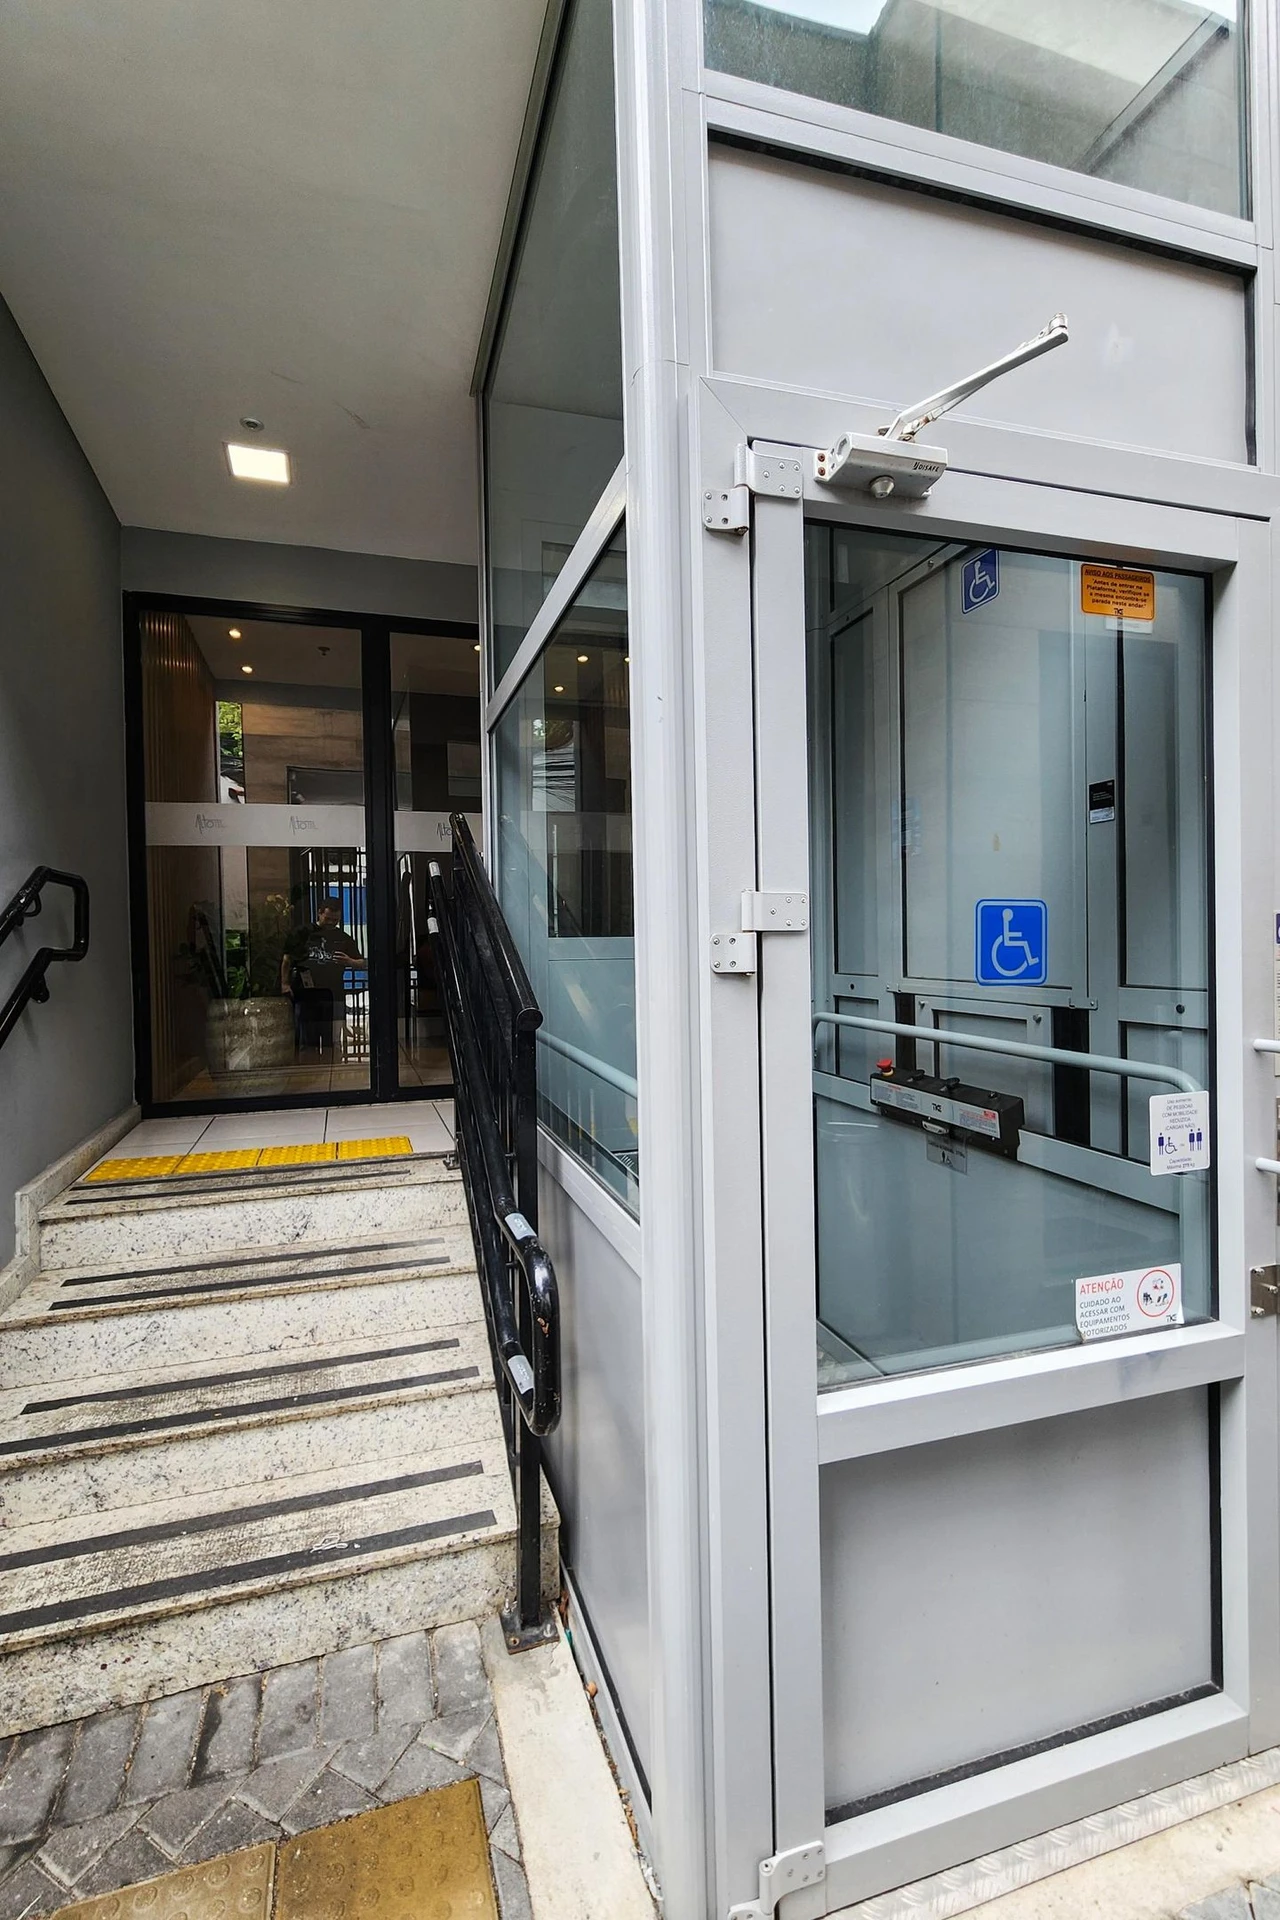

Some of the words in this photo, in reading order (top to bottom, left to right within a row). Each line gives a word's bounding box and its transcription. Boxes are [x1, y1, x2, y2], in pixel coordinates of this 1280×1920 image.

[1086, 584, 1117, 594] Plataforma,
[1080, 1278, 1124, 1295] ATENÇÃO
[1080, 1298, 1110, 1309] CUIDADO
[1080, 1308, 1108, 1319] ACESSAR
[1110, 1305, 1125, 1313] COM
[1080, 1313, 1130, 1328] EQUIPAMENTOS
